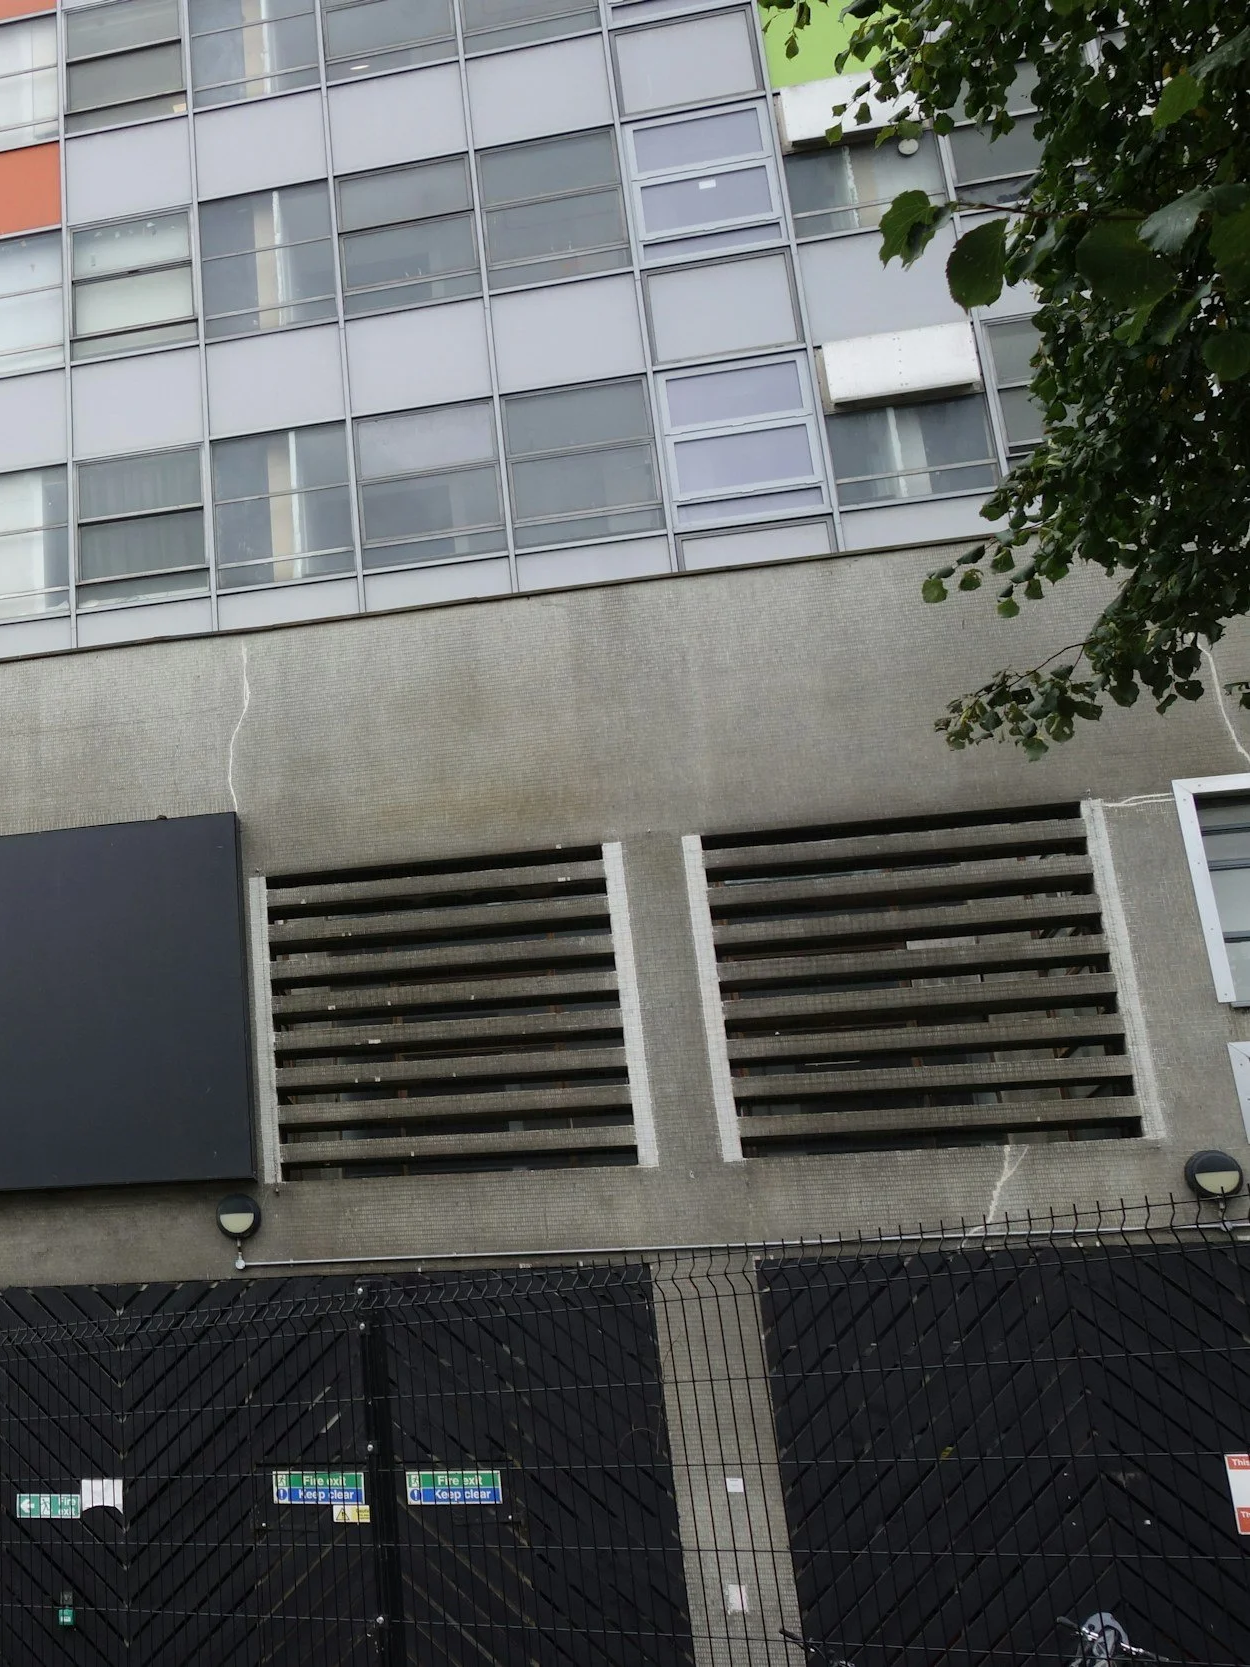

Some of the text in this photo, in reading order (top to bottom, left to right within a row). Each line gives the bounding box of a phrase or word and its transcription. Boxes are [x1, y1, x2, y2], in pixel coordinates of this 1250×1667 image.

[1231, 1458, 1250, 1466] This
[303, 1475, 347, 1486] Fire exit
[437, 1475, 483, 1486] Fire exit
[298, 1489, 355, 1501] Keep clear
[435, 1489, 492, 1501] Keep clear
[58, 1496, 76, 1506] Fire
[58, 1506, 76, 1516] exit
